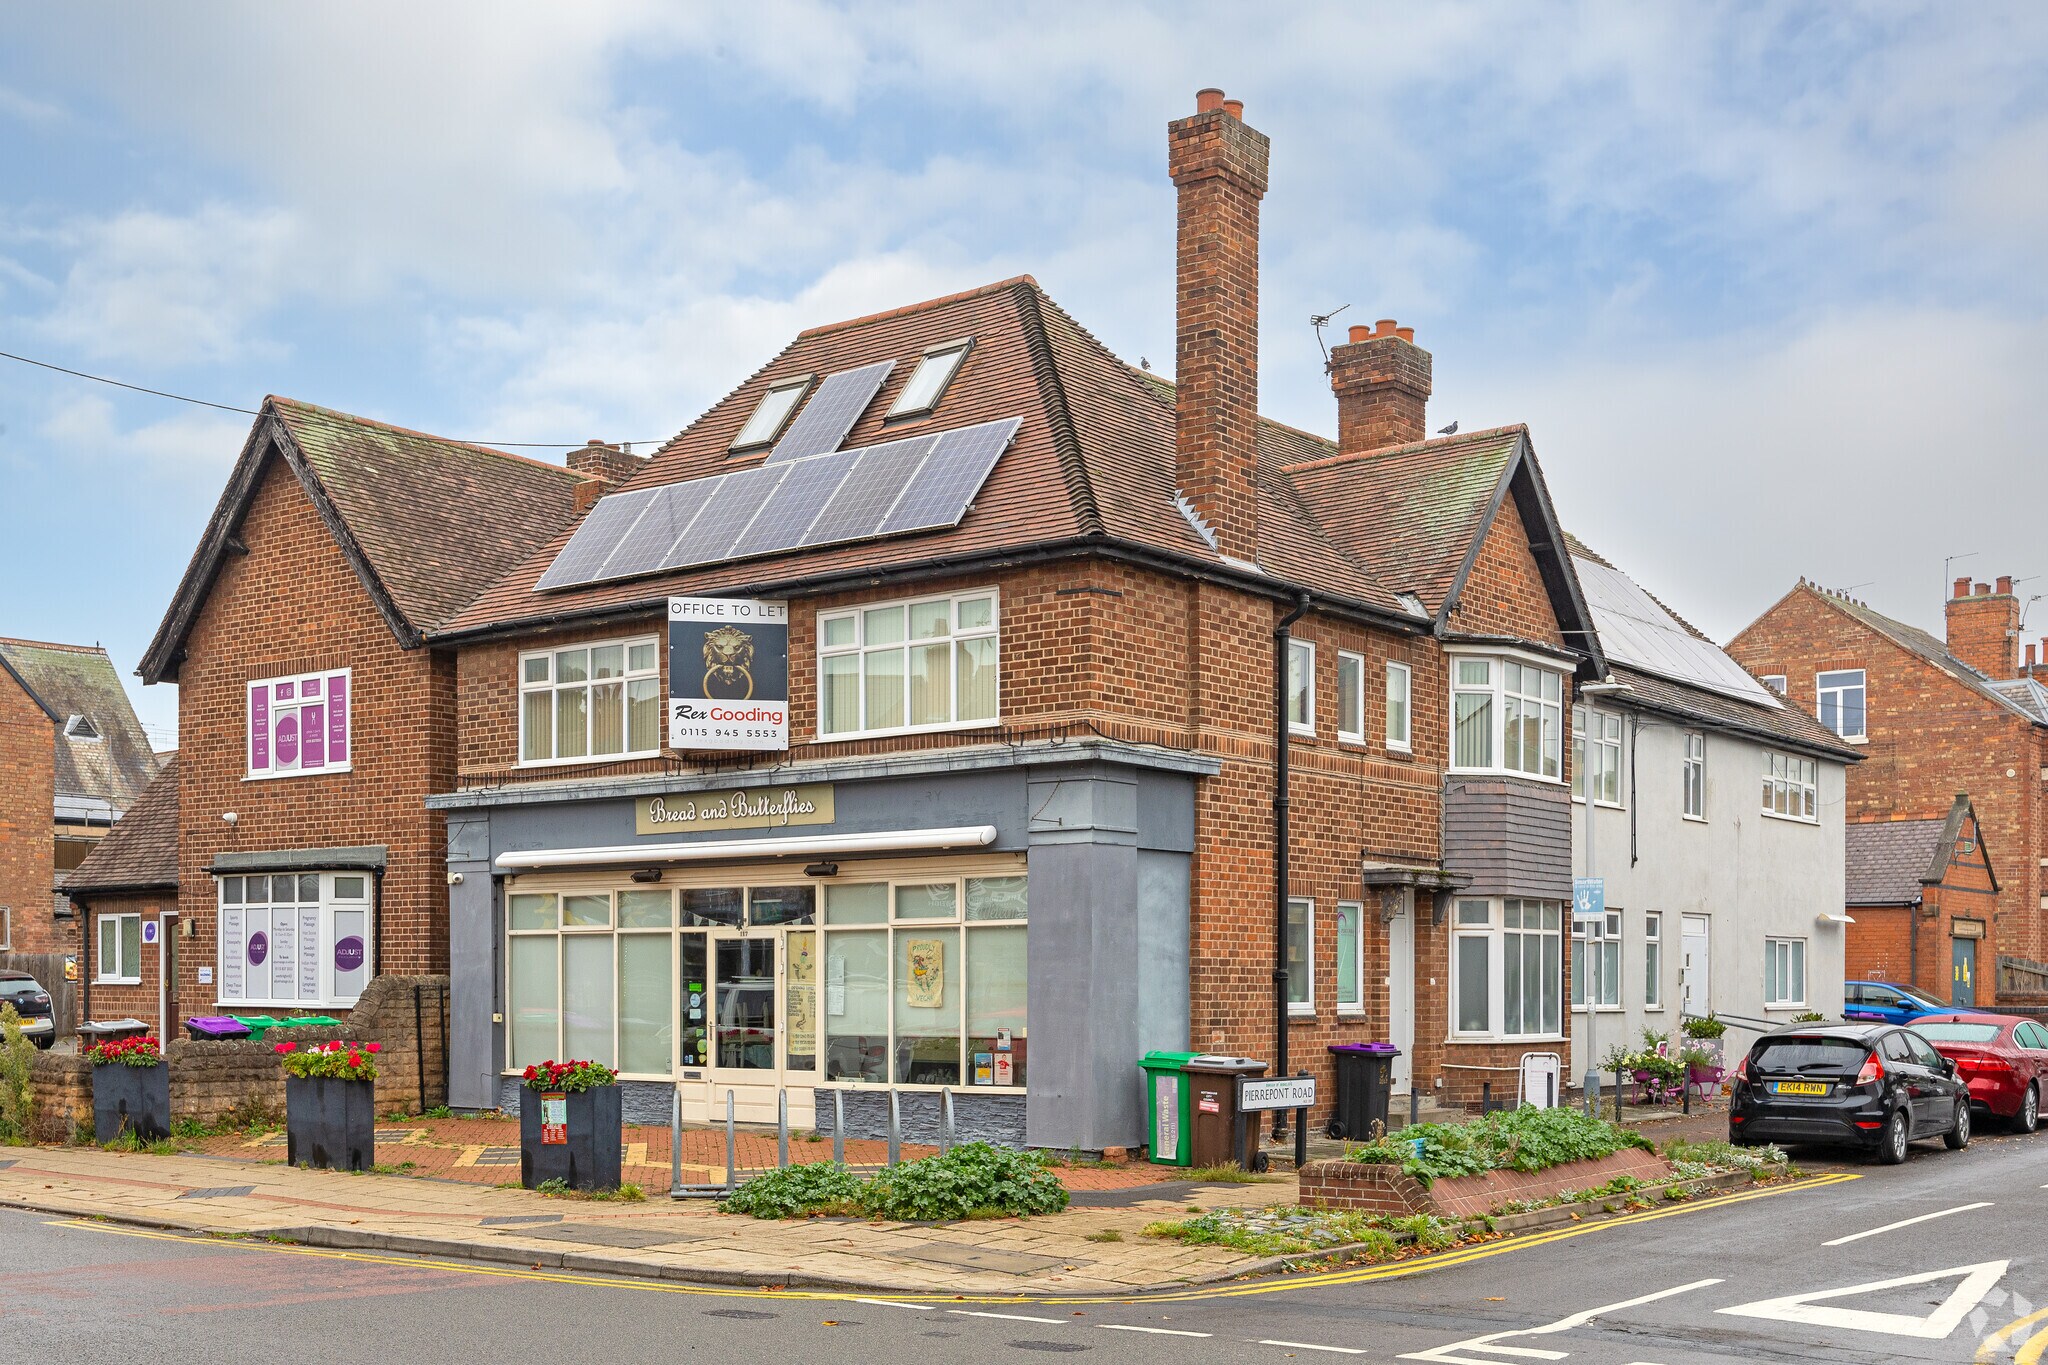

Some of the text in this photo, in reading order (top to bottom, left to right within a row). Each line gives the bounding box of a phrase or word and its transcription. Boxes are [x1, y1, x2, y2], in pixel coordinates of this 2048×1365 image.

[671, 602, 786, 617] OFFICE TO LET
[675, 704, 783, 725] Rex Gooding
[277, 733, 298, 743] ADJUST
[680, 728, 777, 738] 0115 945 5553
[649, 790, 815, 825] Bread and Butterflies
[1244, 1087, 1313, 1101] PIERREPONT ROAD
[1780, 1082, 1823, 1092] EK14 RWN
